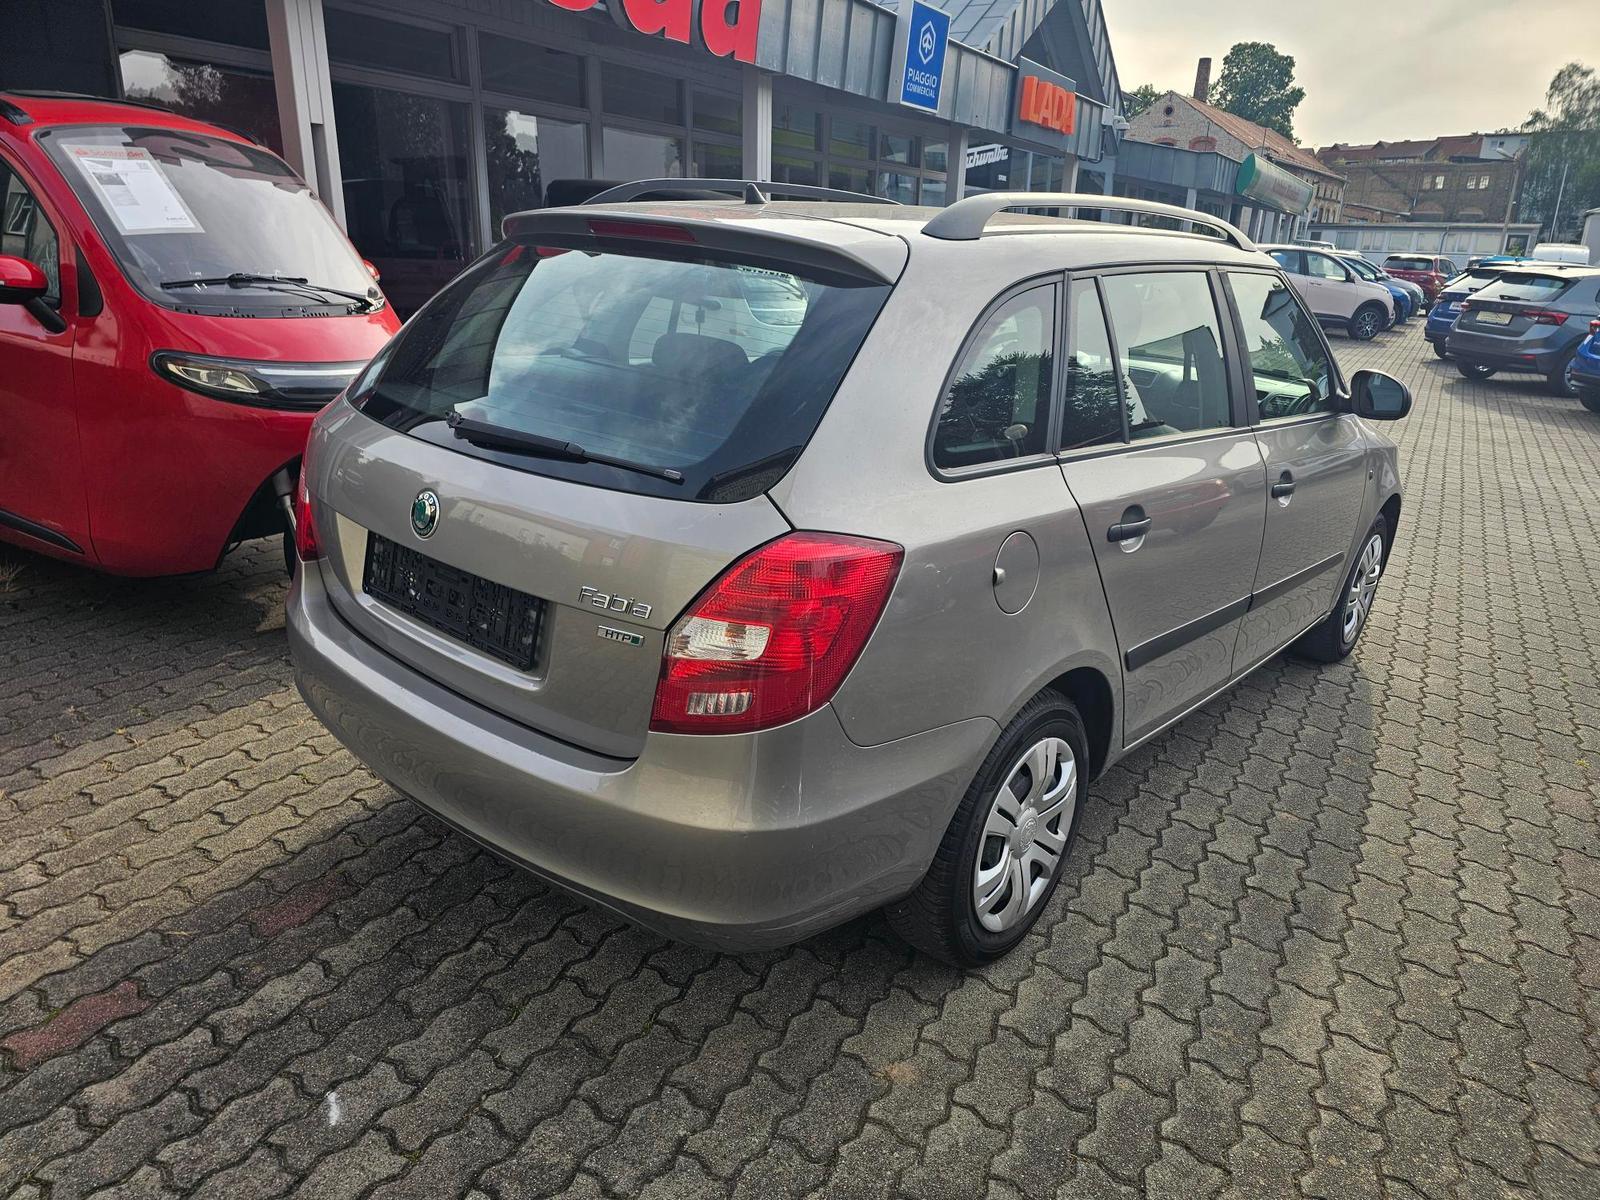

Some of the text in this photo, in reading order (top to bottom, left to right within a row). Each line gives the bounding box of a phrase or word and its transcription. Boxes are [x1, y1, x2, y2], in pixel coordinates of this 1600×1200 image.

[906, 82, 936, 99] COMMERCIAL
[908, 67, 937, 88] PIAGGIO
[1021, 75, 1076, 134] LADA
[578, 586, 652, 619] Fabia
